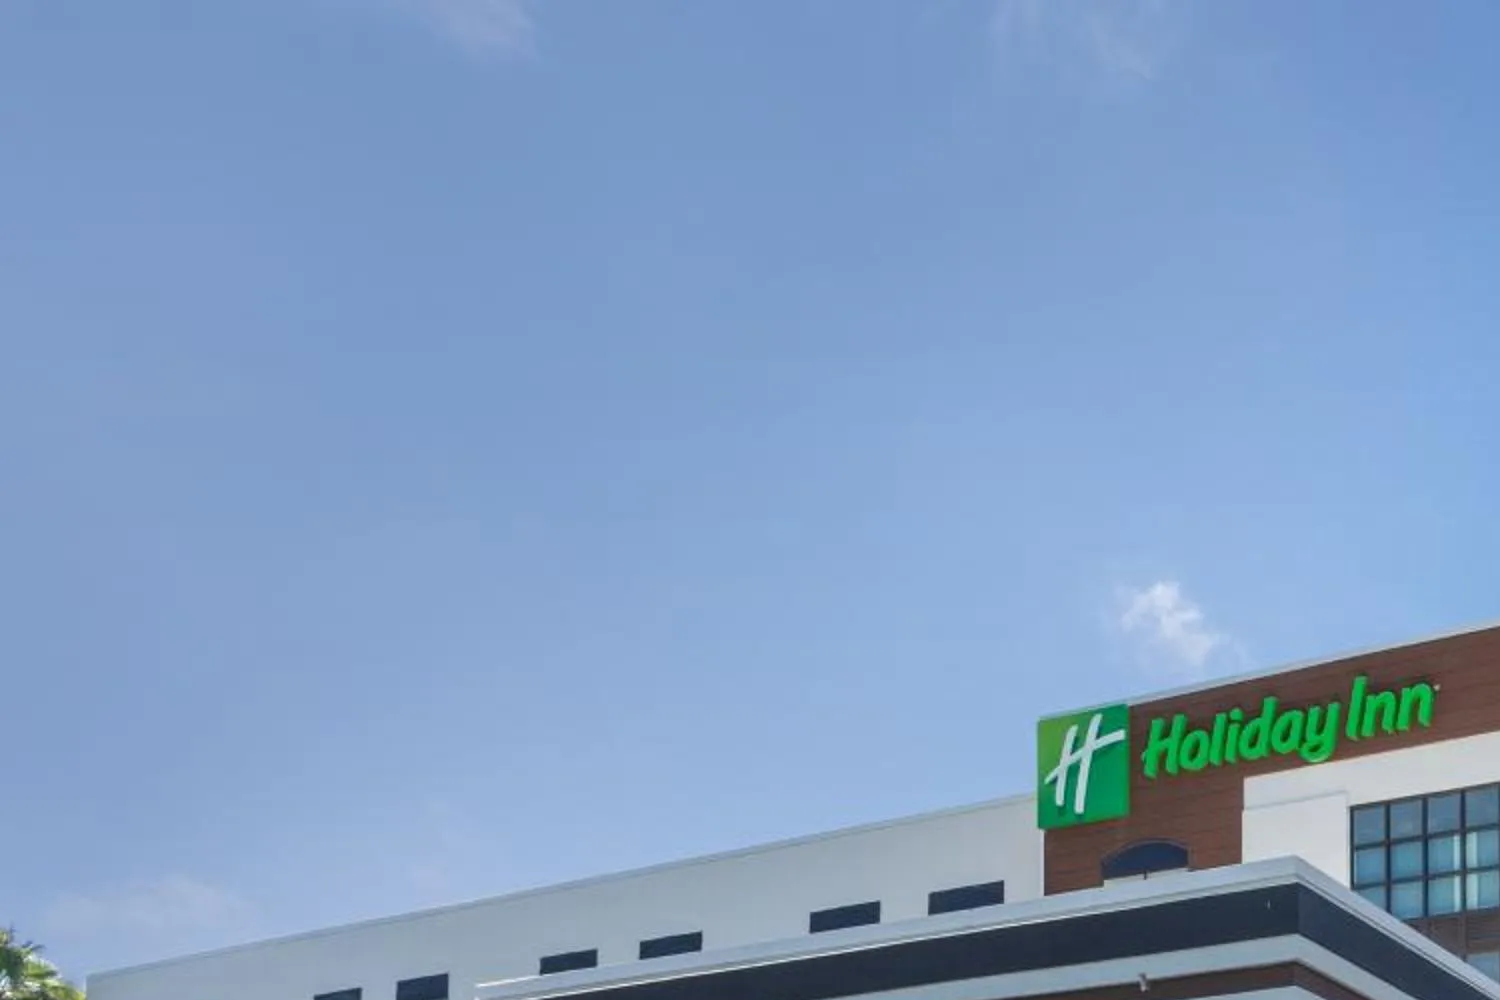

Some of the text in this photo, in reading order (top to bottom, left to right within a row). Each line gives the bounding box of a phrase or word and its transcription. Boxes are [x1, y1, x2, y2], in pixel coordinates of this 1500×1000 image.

[1044, 714, 1125, 814] H
[1143, 676, 1434, 778] Holiday Inn
